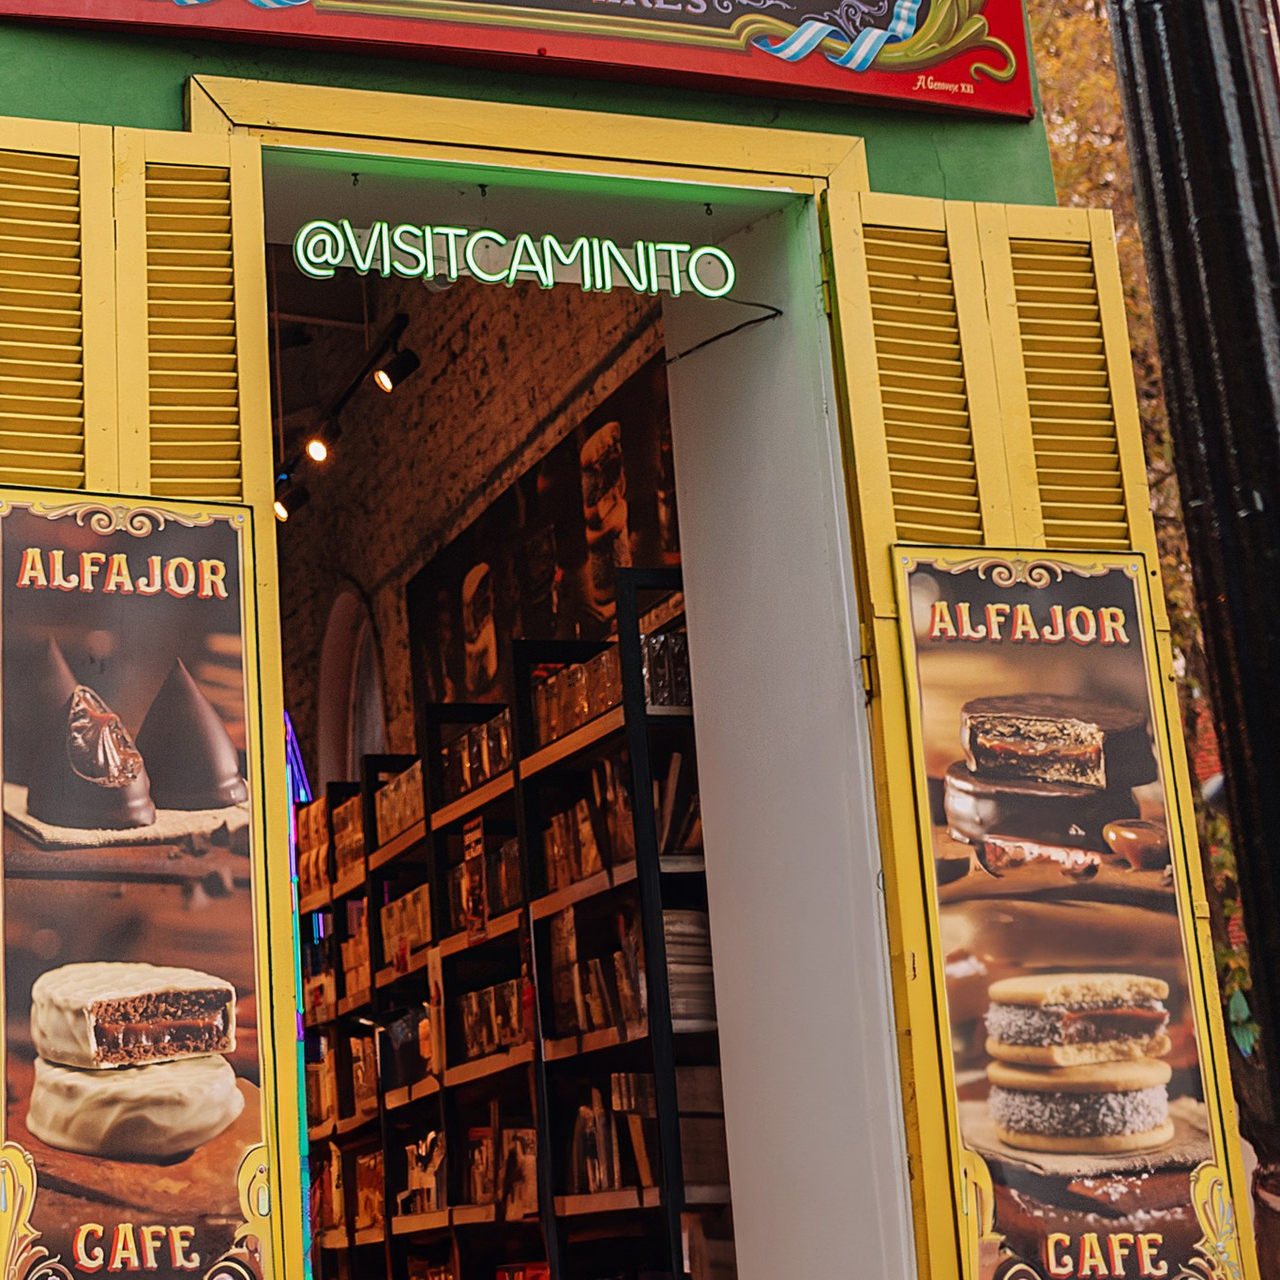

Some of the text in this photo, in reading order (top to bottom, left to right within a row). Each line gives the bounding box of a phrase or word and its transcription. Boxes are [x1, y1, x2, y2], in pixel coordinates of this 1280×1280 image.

[293, 218, 736, 297] @VISITCAMINITO
[16, 546, 229, 601] ALFAJOR
[929, 600, 1131, 645] ALFAJOR
[72, 1222, 201, 1274] CAFE
[1046, 1231, 1169, 1280] CAFE
